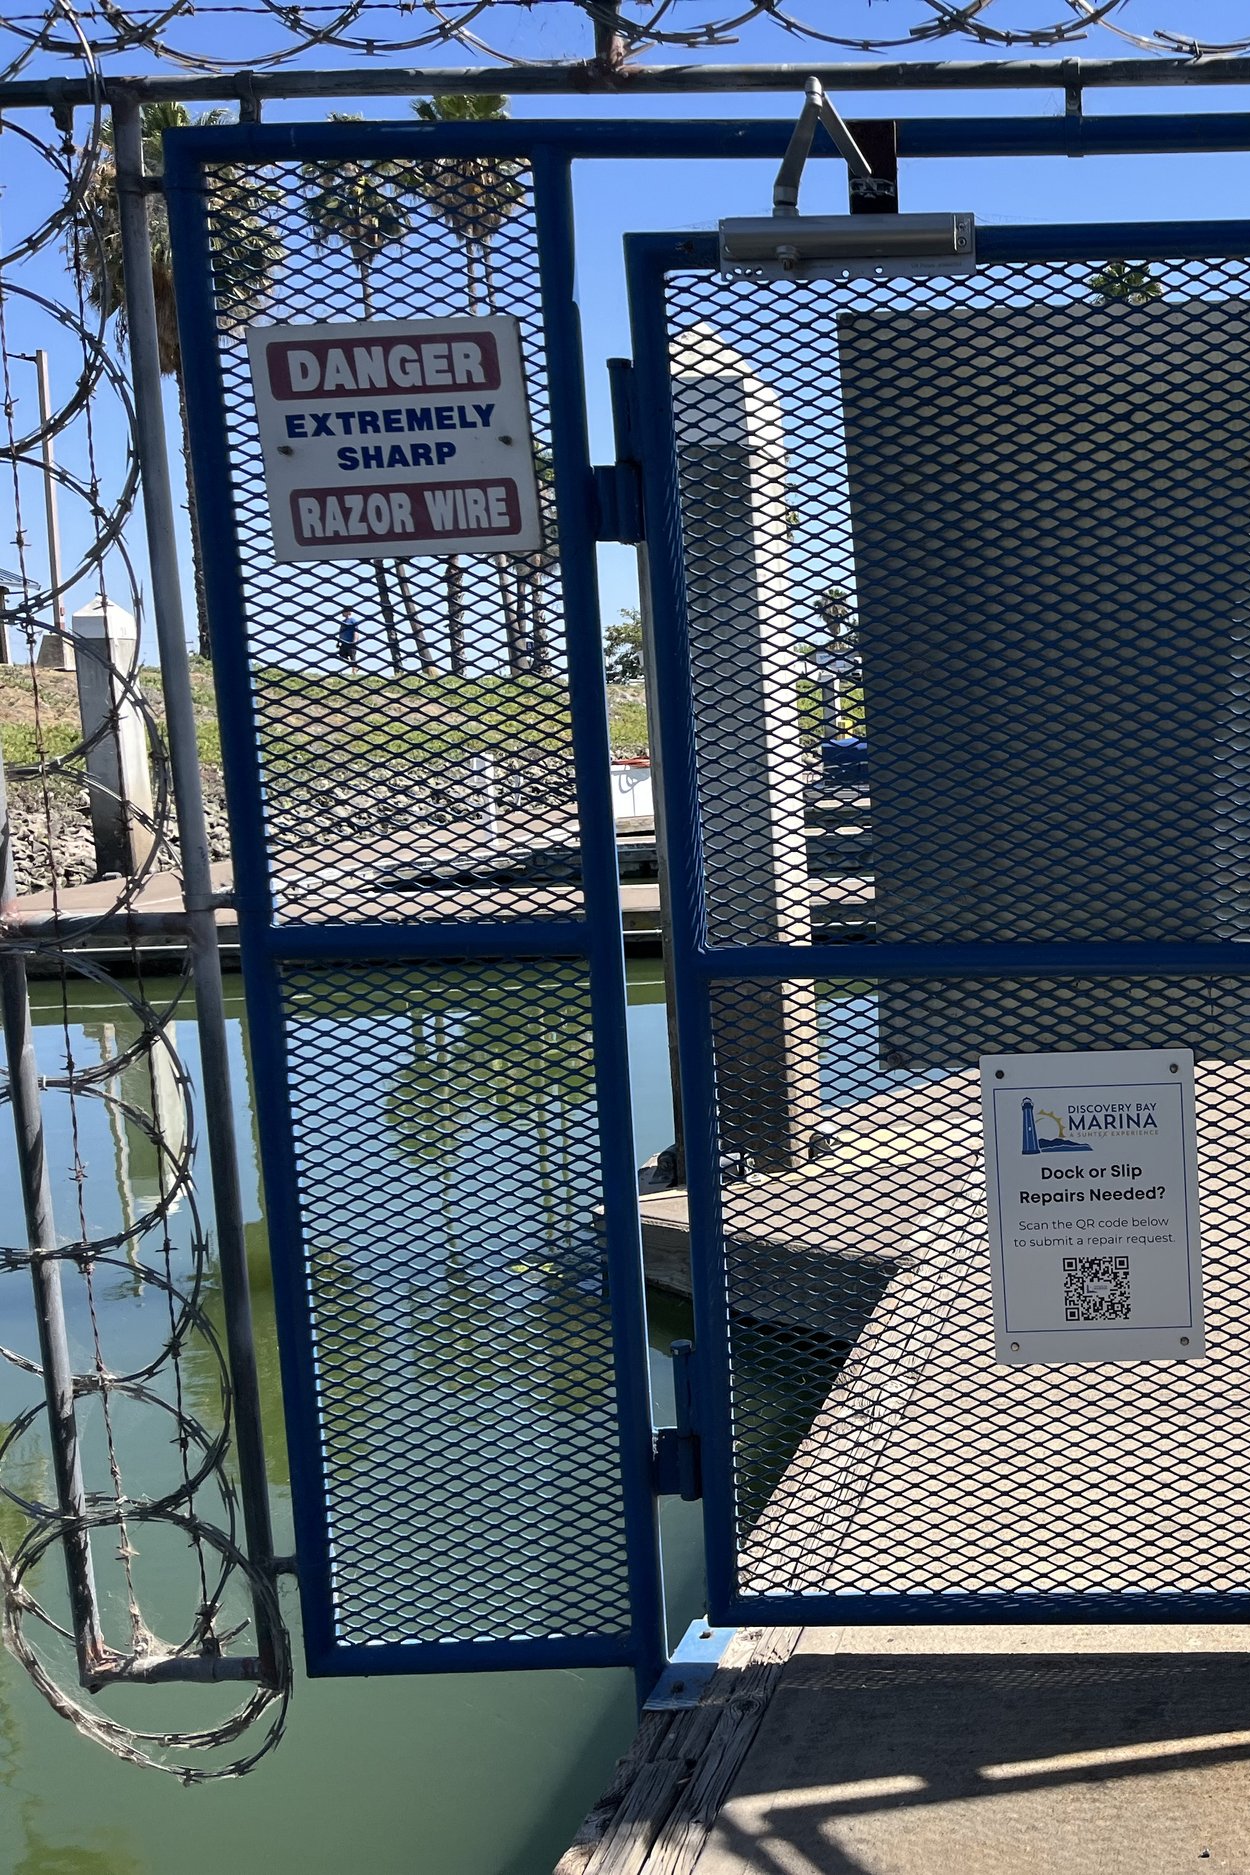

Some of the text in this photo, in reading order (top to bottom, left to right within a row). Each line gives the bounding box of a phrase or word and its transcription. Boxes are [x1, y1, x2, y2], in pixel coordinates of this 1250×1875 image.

[286, 341, 486, 392] DANGER
[285, 403, 496, 439] EXTREMELY
[336, 441, 457, 471] SHARP
[298, 486, 510, 539] RAZOR WIRE
[1067, 1102, 1157, 1114] DISCOVERY BAY
[1068, 1112, 1158, 1131] MARINA
[1111, 1129, 1159, 1137] EXPERIENCE
[1041, 1164, 1143, 1180] Dock or Slip
[1019, 1186, 1166, 1206] Repairs Needed?
[1018, 1216, 1169, 1231] Scan the QR code below
[1013, 1233, 1176, 1248] to submit a repair request.
